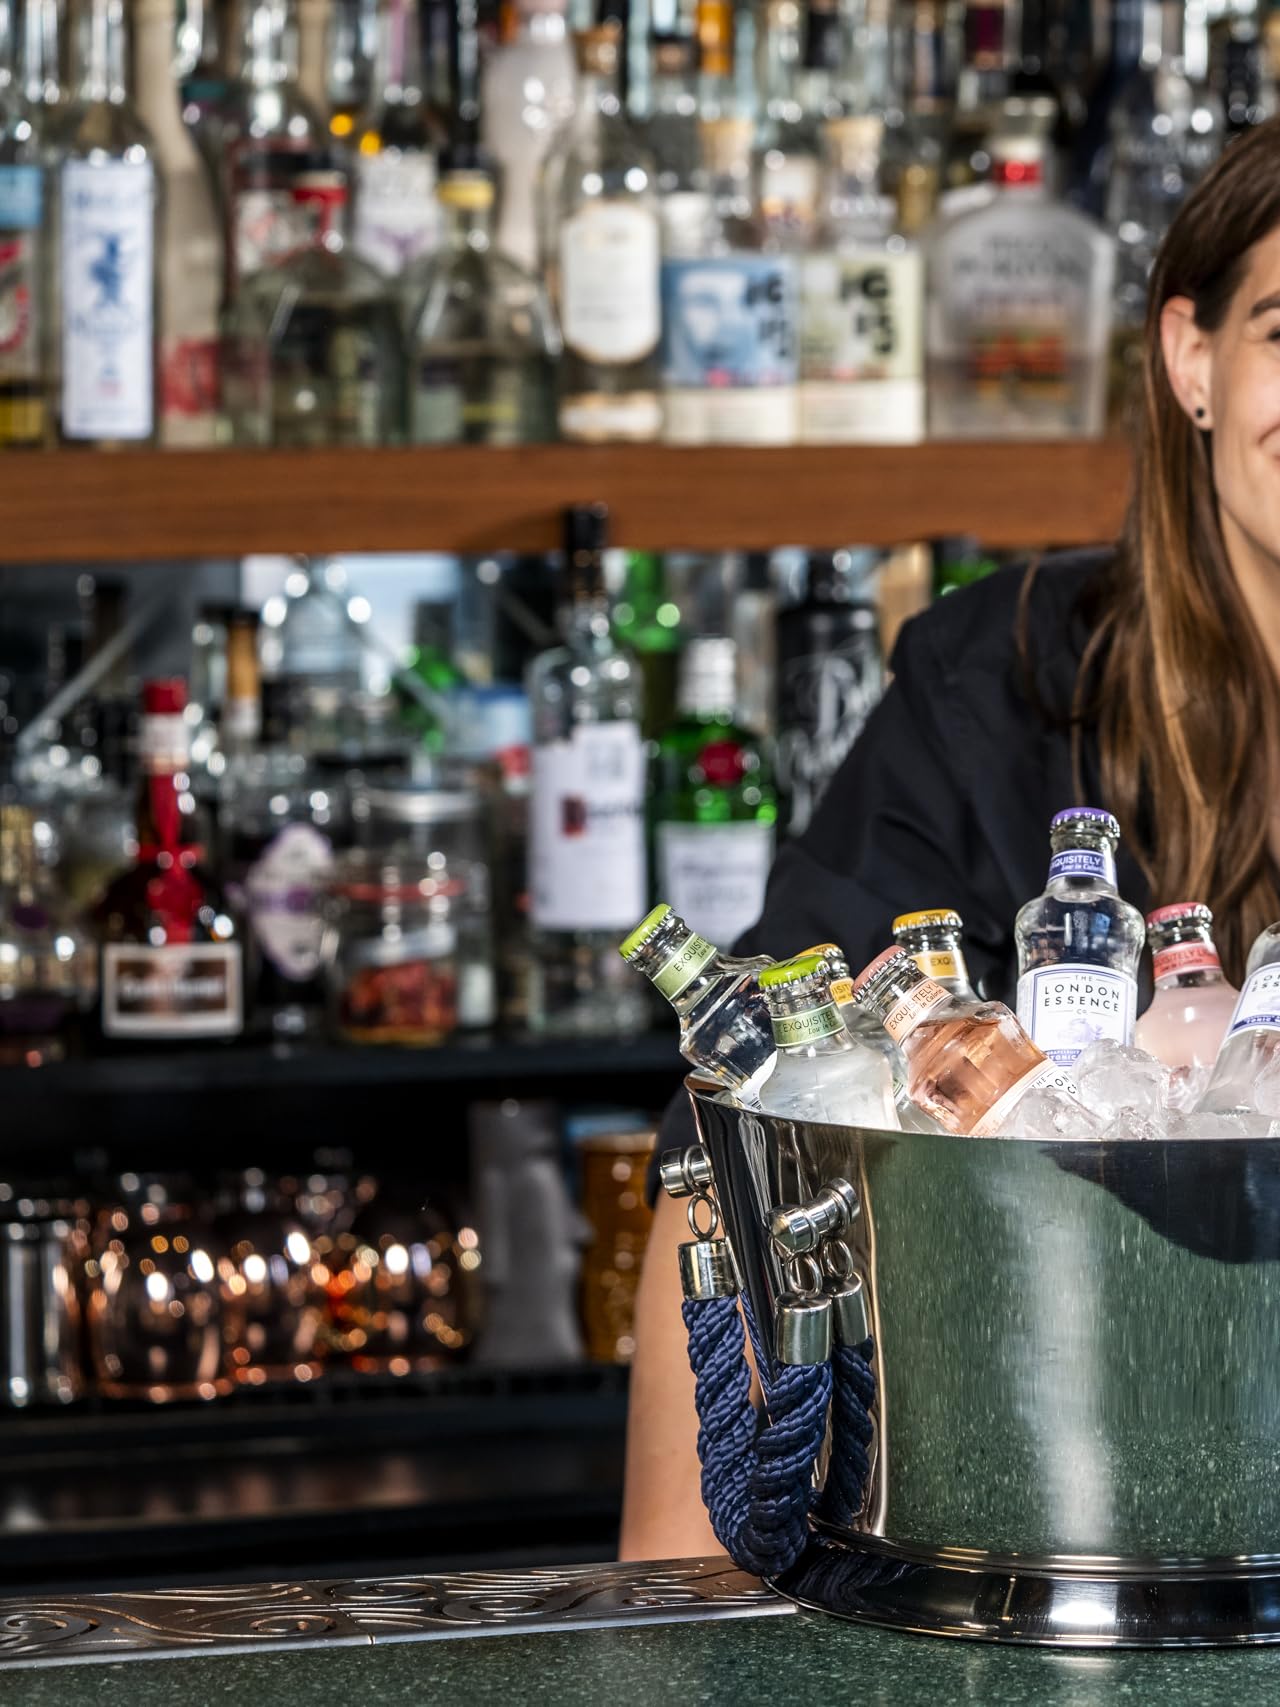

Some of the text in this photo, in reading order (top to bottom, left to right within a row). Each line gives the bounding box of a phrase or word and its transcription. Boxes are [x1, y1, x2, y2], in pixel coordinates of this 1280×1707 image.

[1051, 854, 1101, 869] QUISITELY
[1074, 974, 1093, 982] THE
[1043, 983, 1120, 1001] LONDON
[889, 982, 933, 1031] EXQUISITELY
[1043, 995, 1119, 1013] ESSENCE
